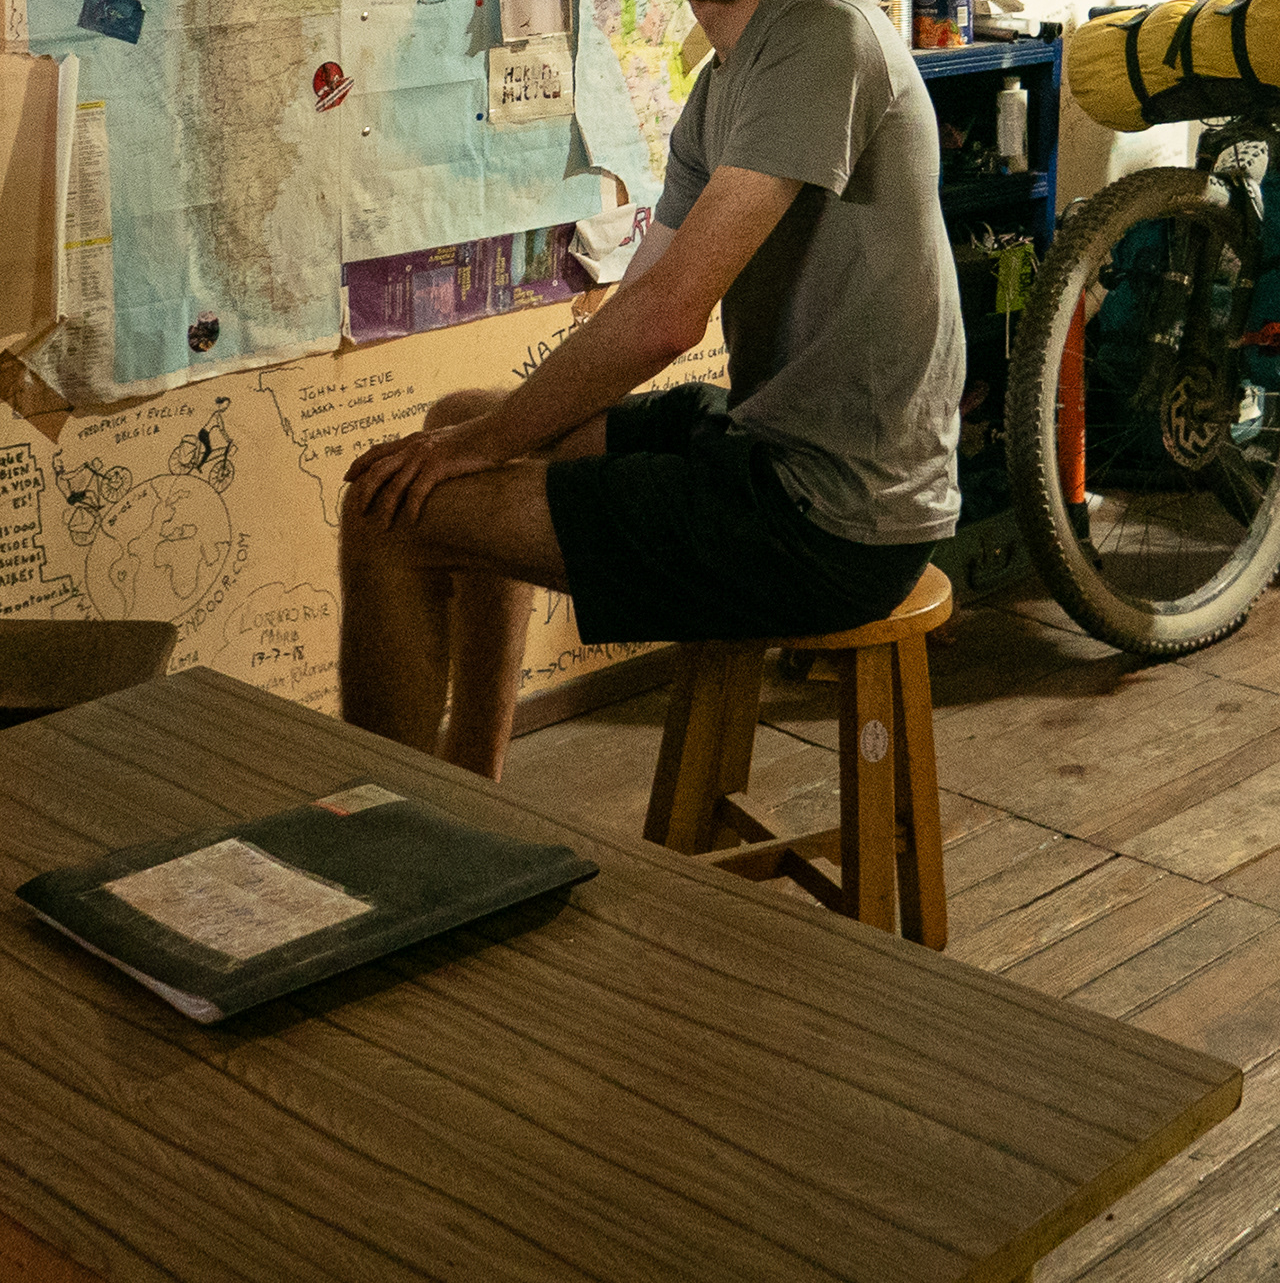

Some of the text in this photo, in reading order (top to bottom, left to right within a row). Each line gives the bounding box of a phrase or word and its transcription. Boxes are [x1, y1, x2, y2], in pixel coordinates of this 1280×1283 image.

[299, 384, 336, 402] JOHN
[354, 370, 394, 389] STEVE
[10, 477, 42, 492] VIDA
